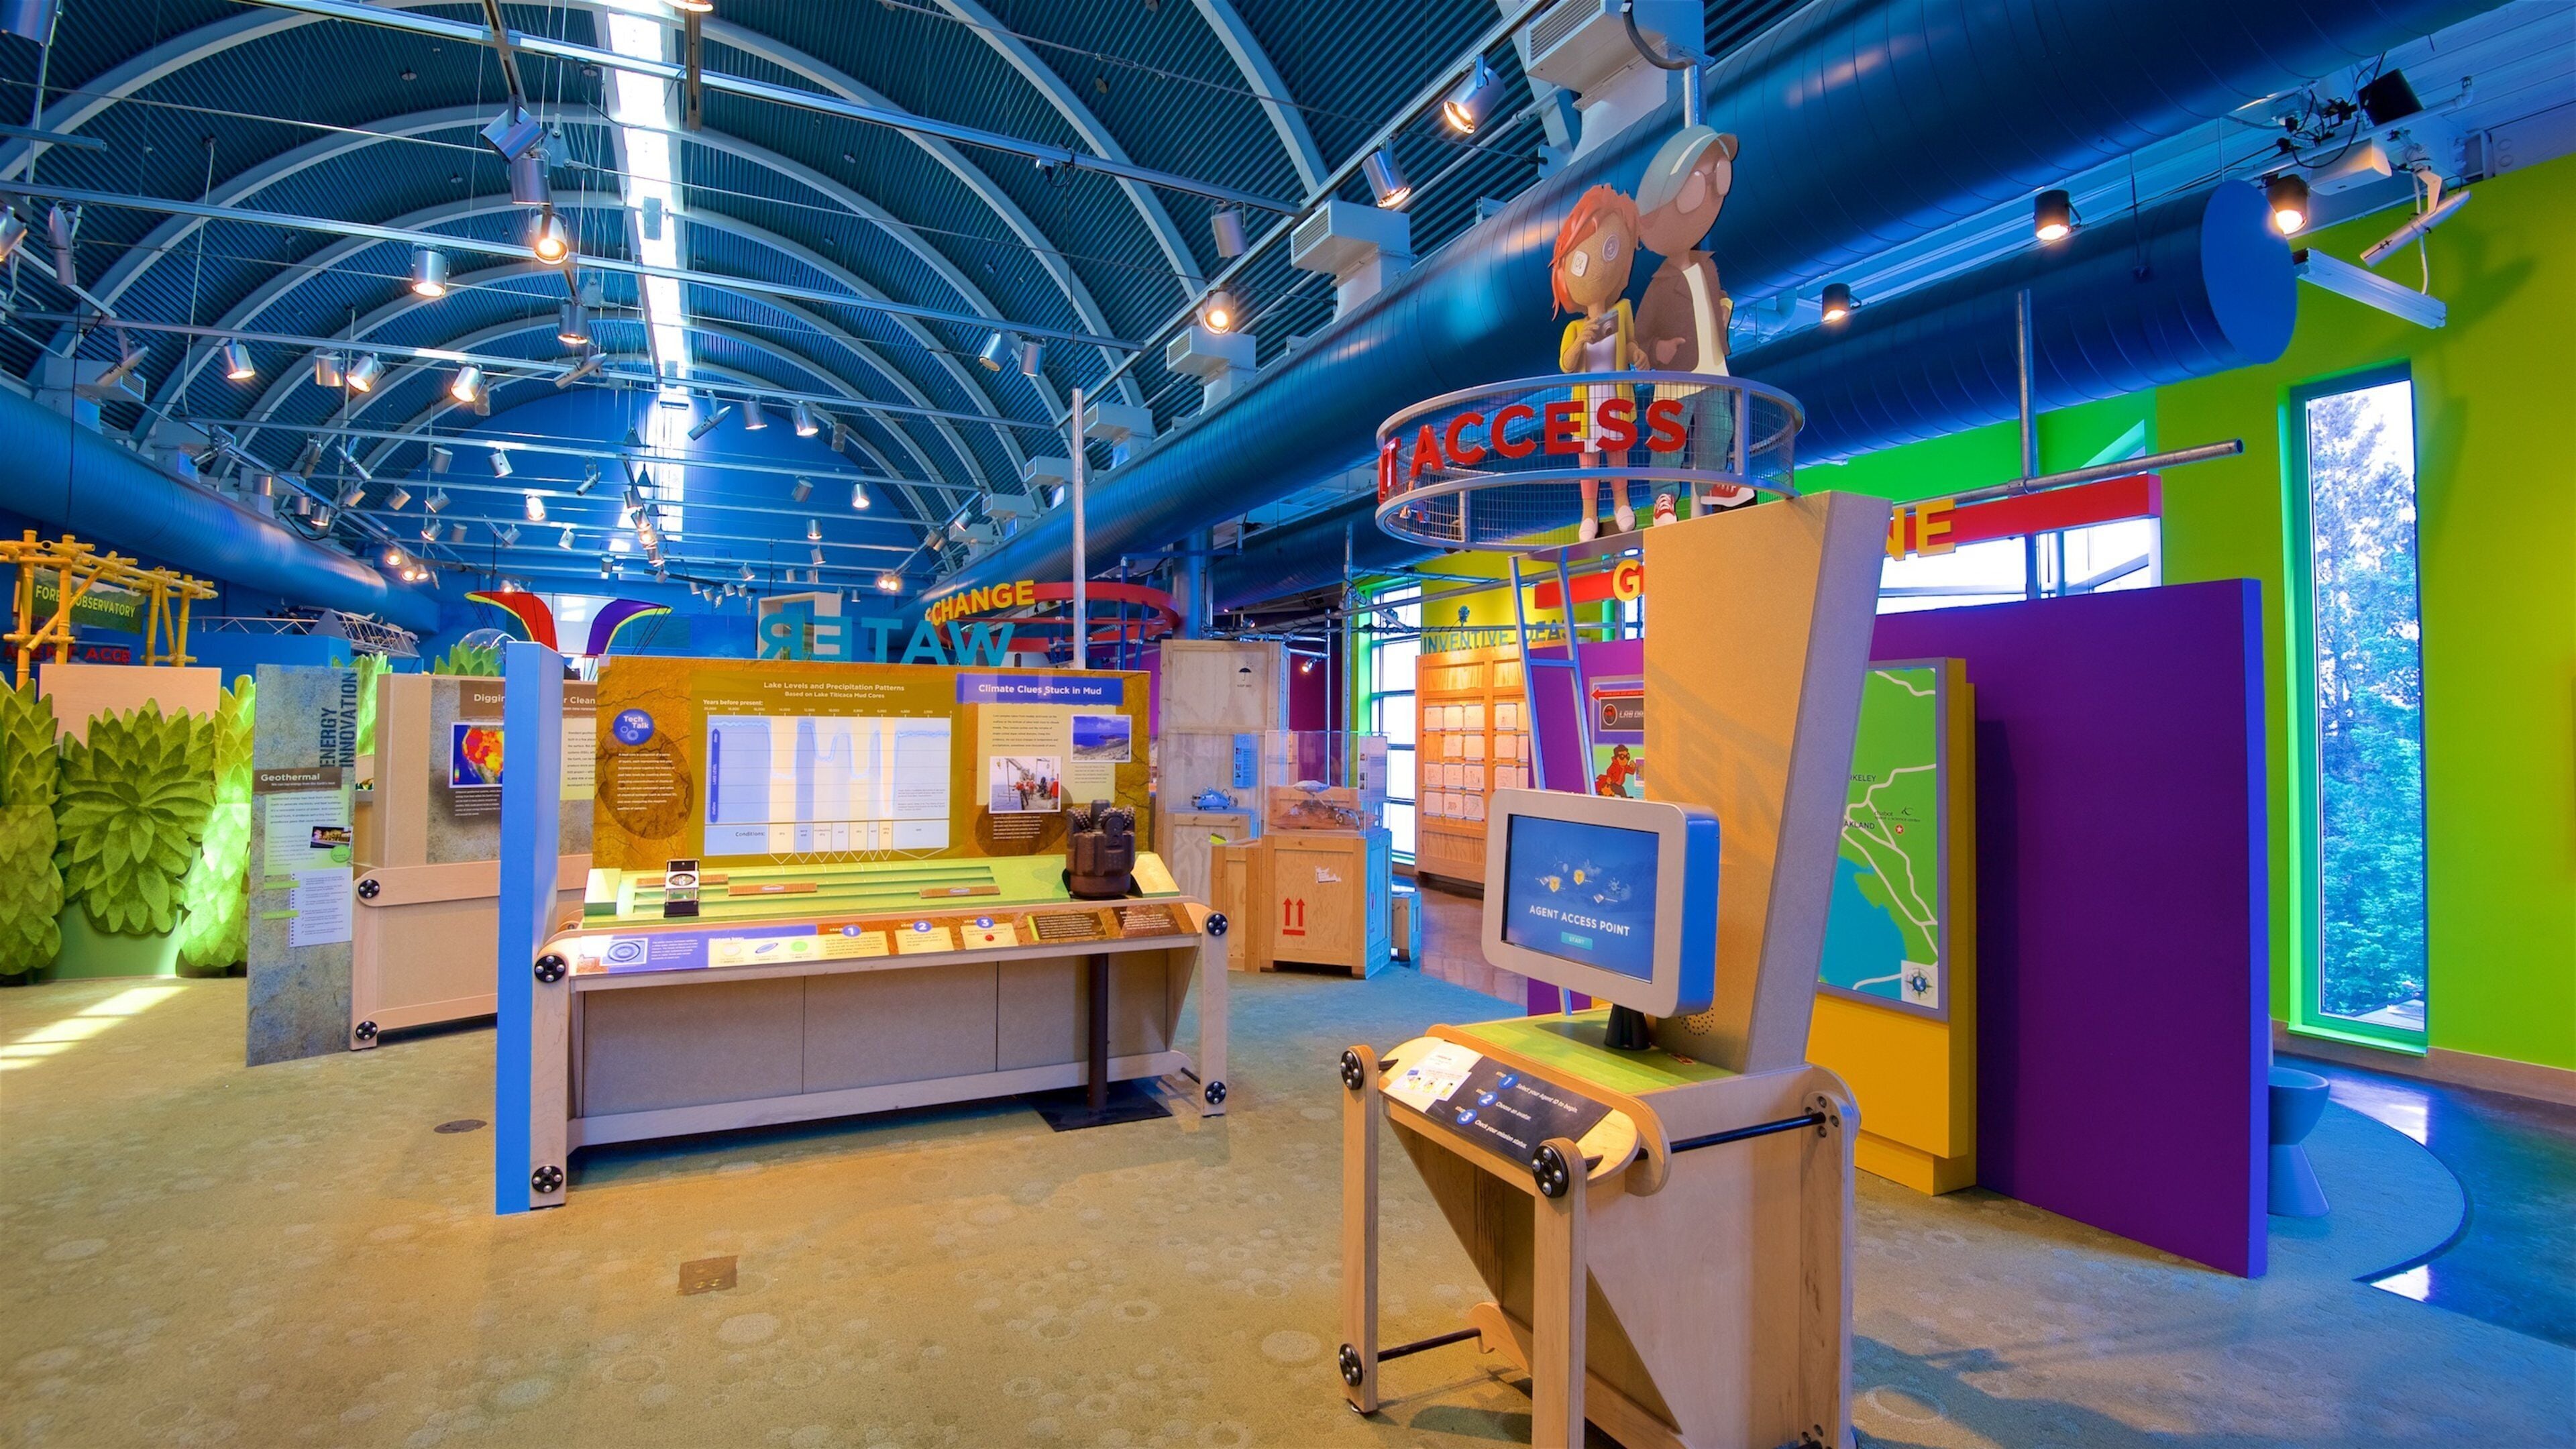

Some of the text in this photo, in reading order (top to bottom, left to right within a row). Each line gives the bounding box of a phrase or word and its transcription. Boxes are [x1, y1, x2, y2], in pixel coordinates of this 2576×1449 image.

[1410, 398, 1688, 478] ACCESS
[75, 595, 136, 618] OBSERVATORY
[932, 580, 1036, 626] CHANGE
[1424, 628, 1509, 655] INVENTIVE
[979, 684, 1102, 695] Climate Clues Stuck in Mud
[339, 672, 357, 767] INNOVATION
[320, 707, 337, 767] ENERGY
[1529, 905, 1630, 936] AGENT ACCESS POINT
[1503, 1077, 1512, 1085] 1
[1481, 1095, 1493, 1104] 2
[1516, 1083, 1531, 1093] Select
[1528, 1089, 1541, 1097] your
[1539, 1093, 1554, 1104] Agent
[1461, 1113, 1472, 1122] 3
[1495, 1102, 1512, 1112] Choose
[1474, 1119, 1489, 1130] Check
